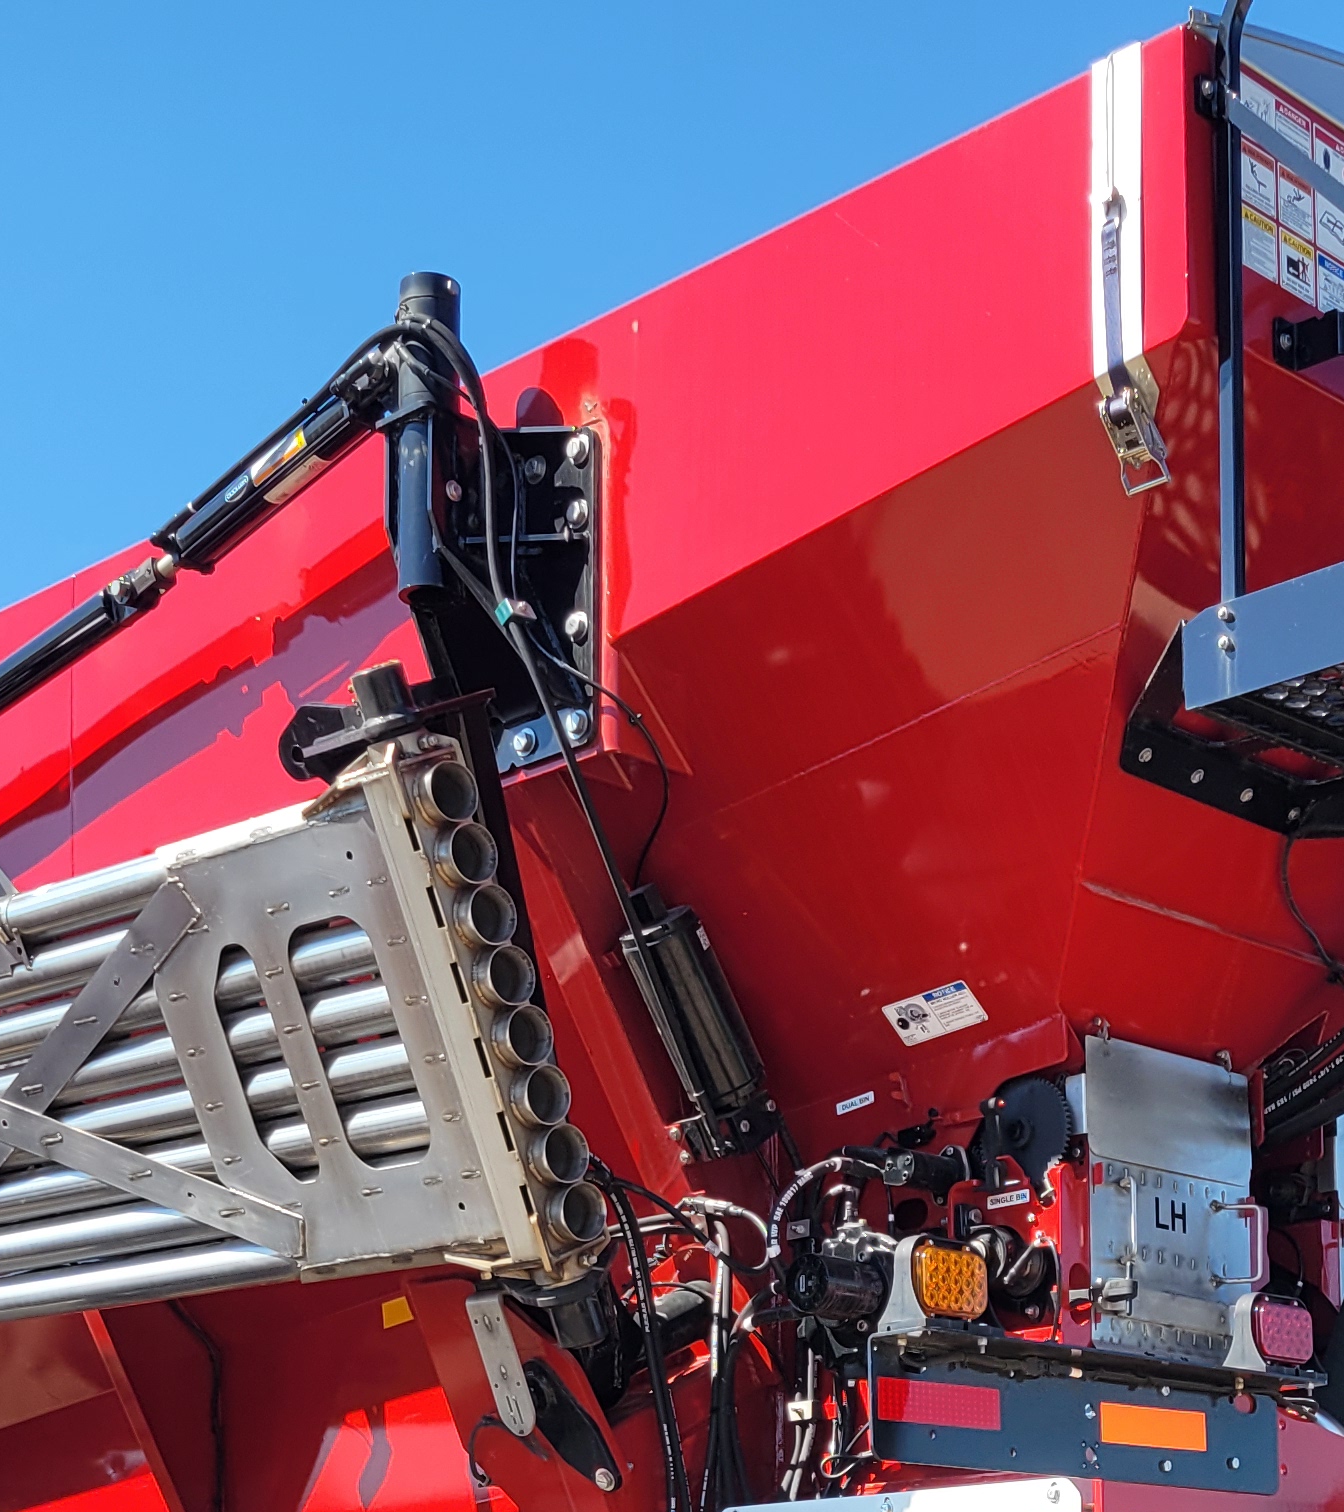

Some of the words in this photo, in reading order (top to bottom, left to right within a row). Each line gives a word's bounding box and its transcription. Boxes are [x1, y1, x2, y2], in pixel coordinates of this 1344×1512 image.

[1250, 213, 1274, 234] CAUTION
[1288, 236, 1312, 257] CAUTION
[932, 986, 956, 999] NOTICE
[842, 1100, 858, 1110] DUAL
[859, 1095, 870, 1104] BIN
[989, 1195, 1015, 1206] SINGLE
[1016, 1192, 1027, 1202] BIN
[773, 1206, 784, 1222] SAE
[1154, 1196, 1187, 1234] LH
